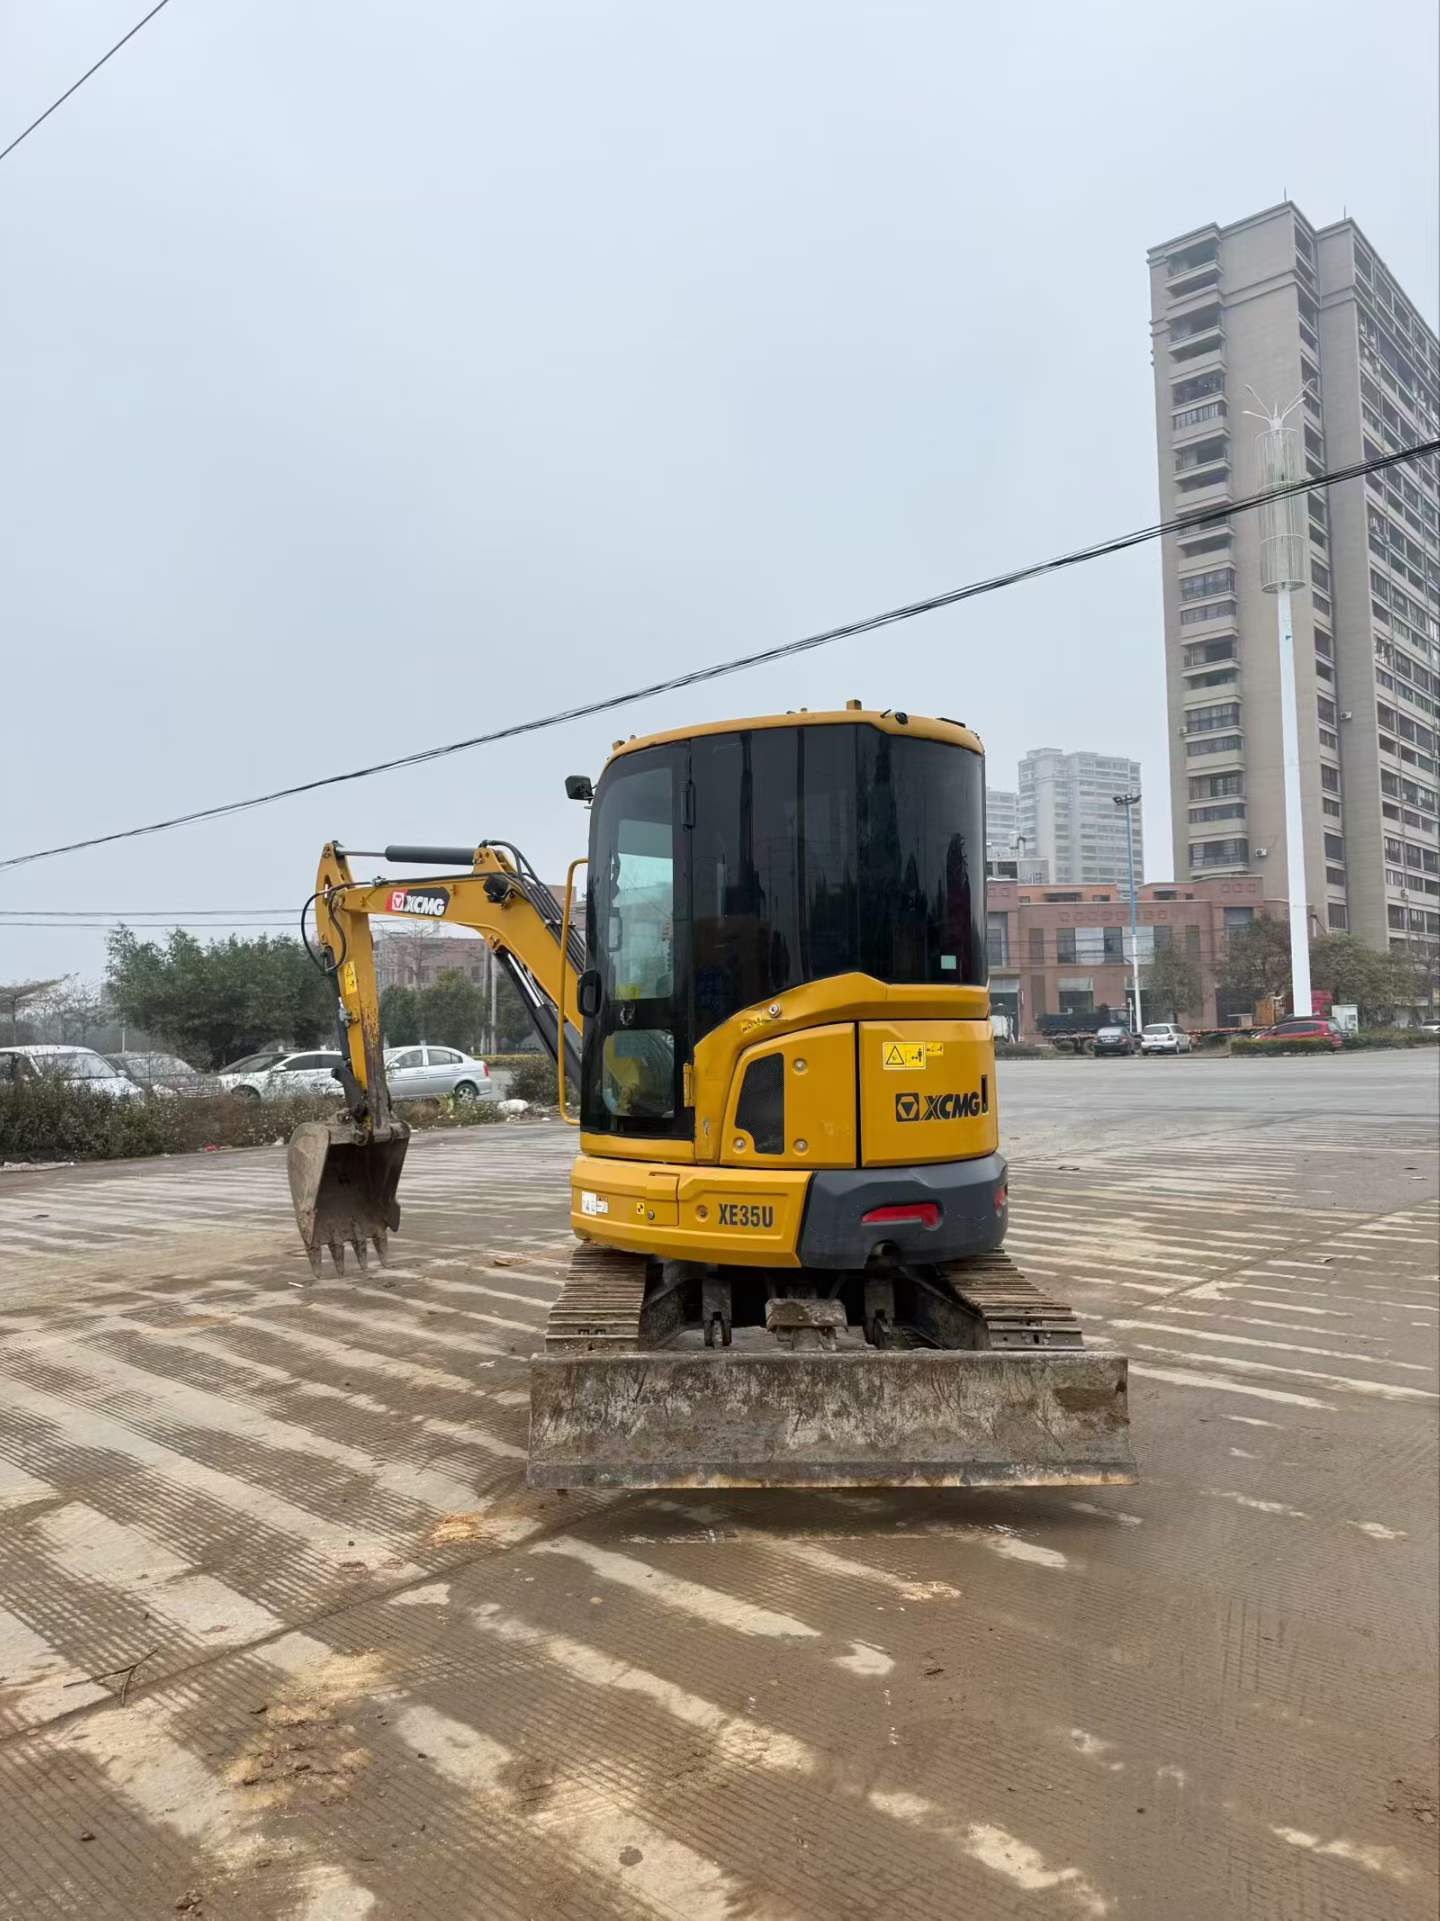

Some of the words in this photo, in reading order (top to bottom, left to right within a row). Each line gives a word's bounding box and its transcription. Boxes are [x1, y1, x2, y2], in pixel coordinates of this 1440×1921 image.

[402, 895, 445, 916] XCMG
[921, 1092, 980, 1120] XCMG
[718, 1203, 774, 1228] XE35U
